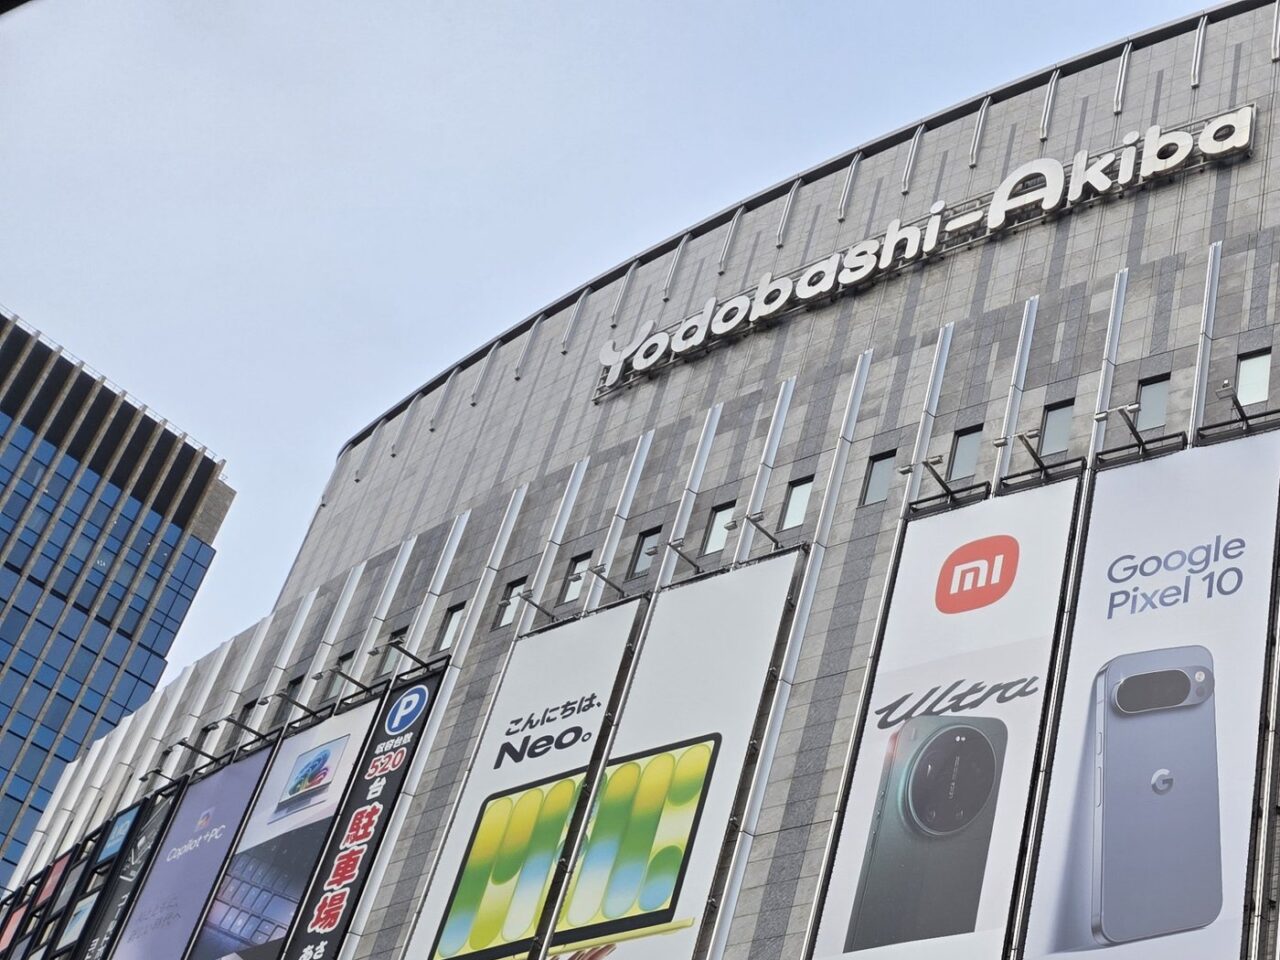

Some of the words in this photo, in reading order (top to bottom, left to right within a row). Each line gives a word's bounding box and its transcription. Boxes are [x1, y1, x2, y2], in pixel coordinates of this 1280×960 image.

[600, 103, 1257, 388] Yodobashi-Akiba
[1107, 534, 1246, 584] Google
[1107, 575, 1191, 620] Pixel
[1201, 566, 1243, 598] 10
[392, 692, 419, 729] P
[874, 675, 1039, 729] Ultra
[365, 747, 407, 780] 520
[366, 776, 387, 800] 台
[307, 801, 384, 933] 駐車場
